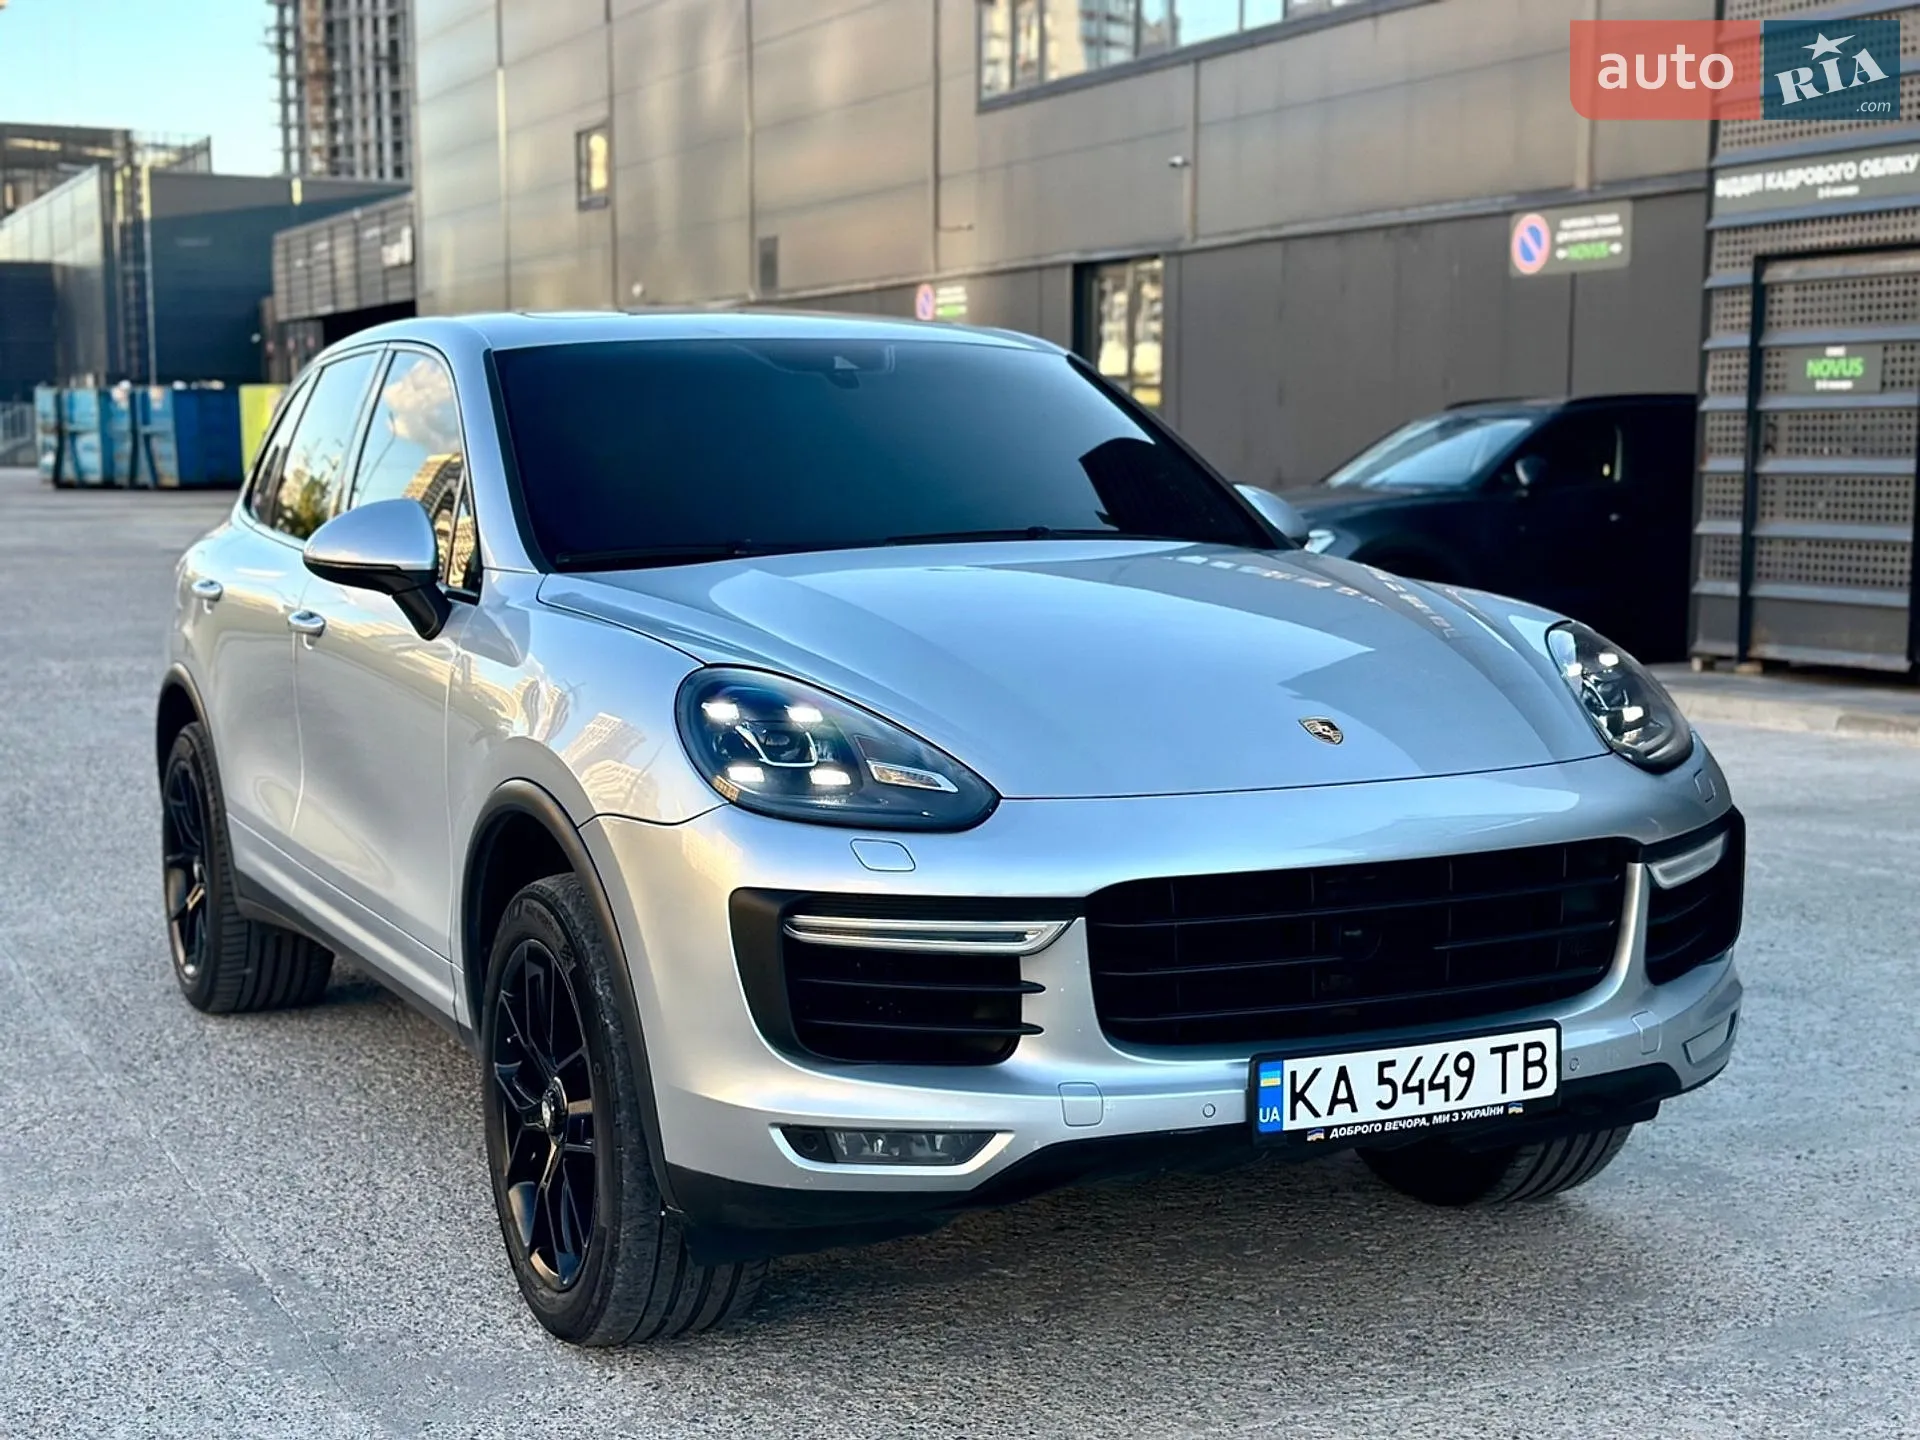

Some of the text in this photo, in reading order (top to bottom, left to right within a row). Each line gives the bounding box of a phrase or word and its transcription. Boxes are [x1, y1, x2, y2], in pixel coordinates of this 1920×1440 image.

[1765, 161, 1858, 191] КАДРОВОГО
[1806, 357, 1864, 378] NOVUS
[1259, 1107, 1281, 1123] UA
[1376, 1051, 1476, 1111] 5449
[1329, 1123, 1383, 1139] ДОБРОГО
[1384, 1117, 1430, 1132] ВЕЧОРА,
[1432, 1113, 1451, 1125] МИ
[1461, 1105, 1504, 1121] УКРАЇНИ
